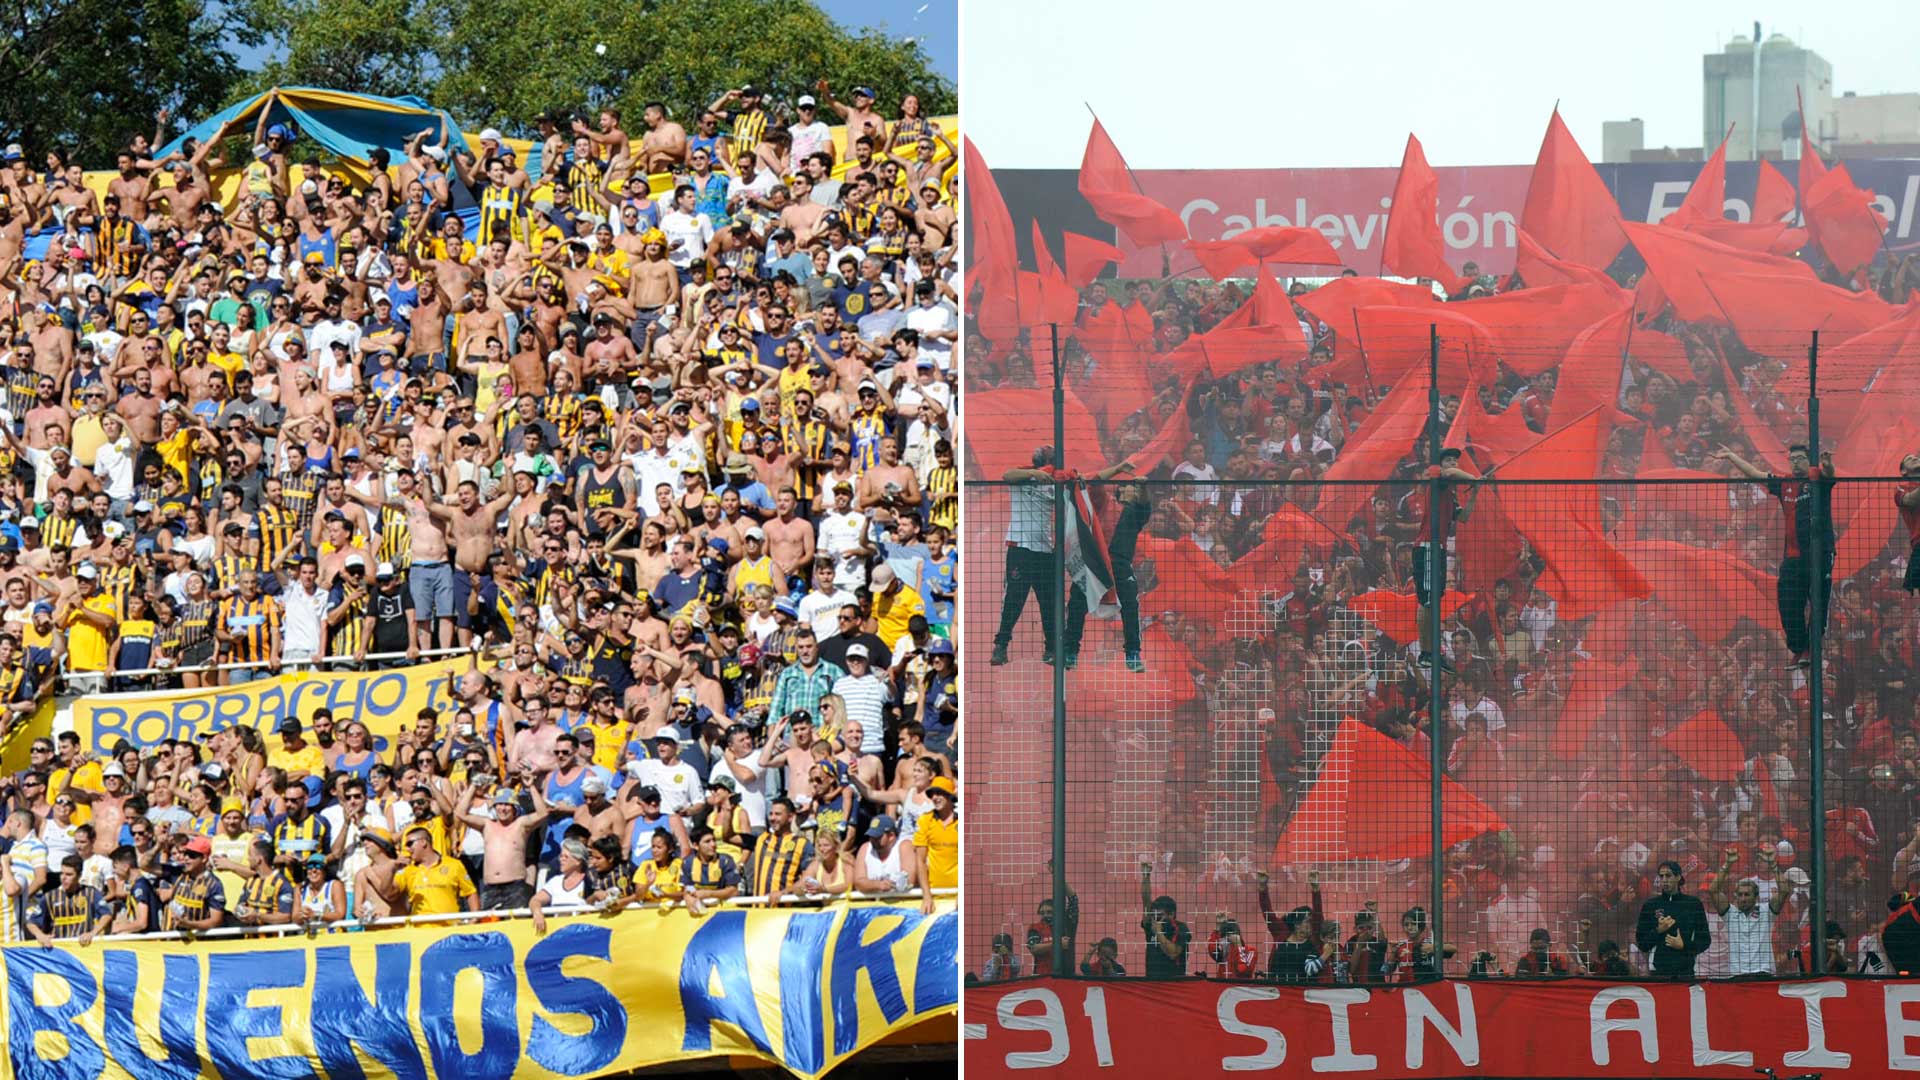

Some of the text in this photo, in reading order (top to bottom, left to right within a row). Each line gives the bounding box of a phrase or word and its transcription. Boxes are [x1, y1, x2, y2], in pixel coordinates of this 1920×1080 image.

[90, 673, 408, 756] BORRACHO
[2, 922, 628, 1080] BUENOS
[1217, 984, 1479, 1072] SIN
